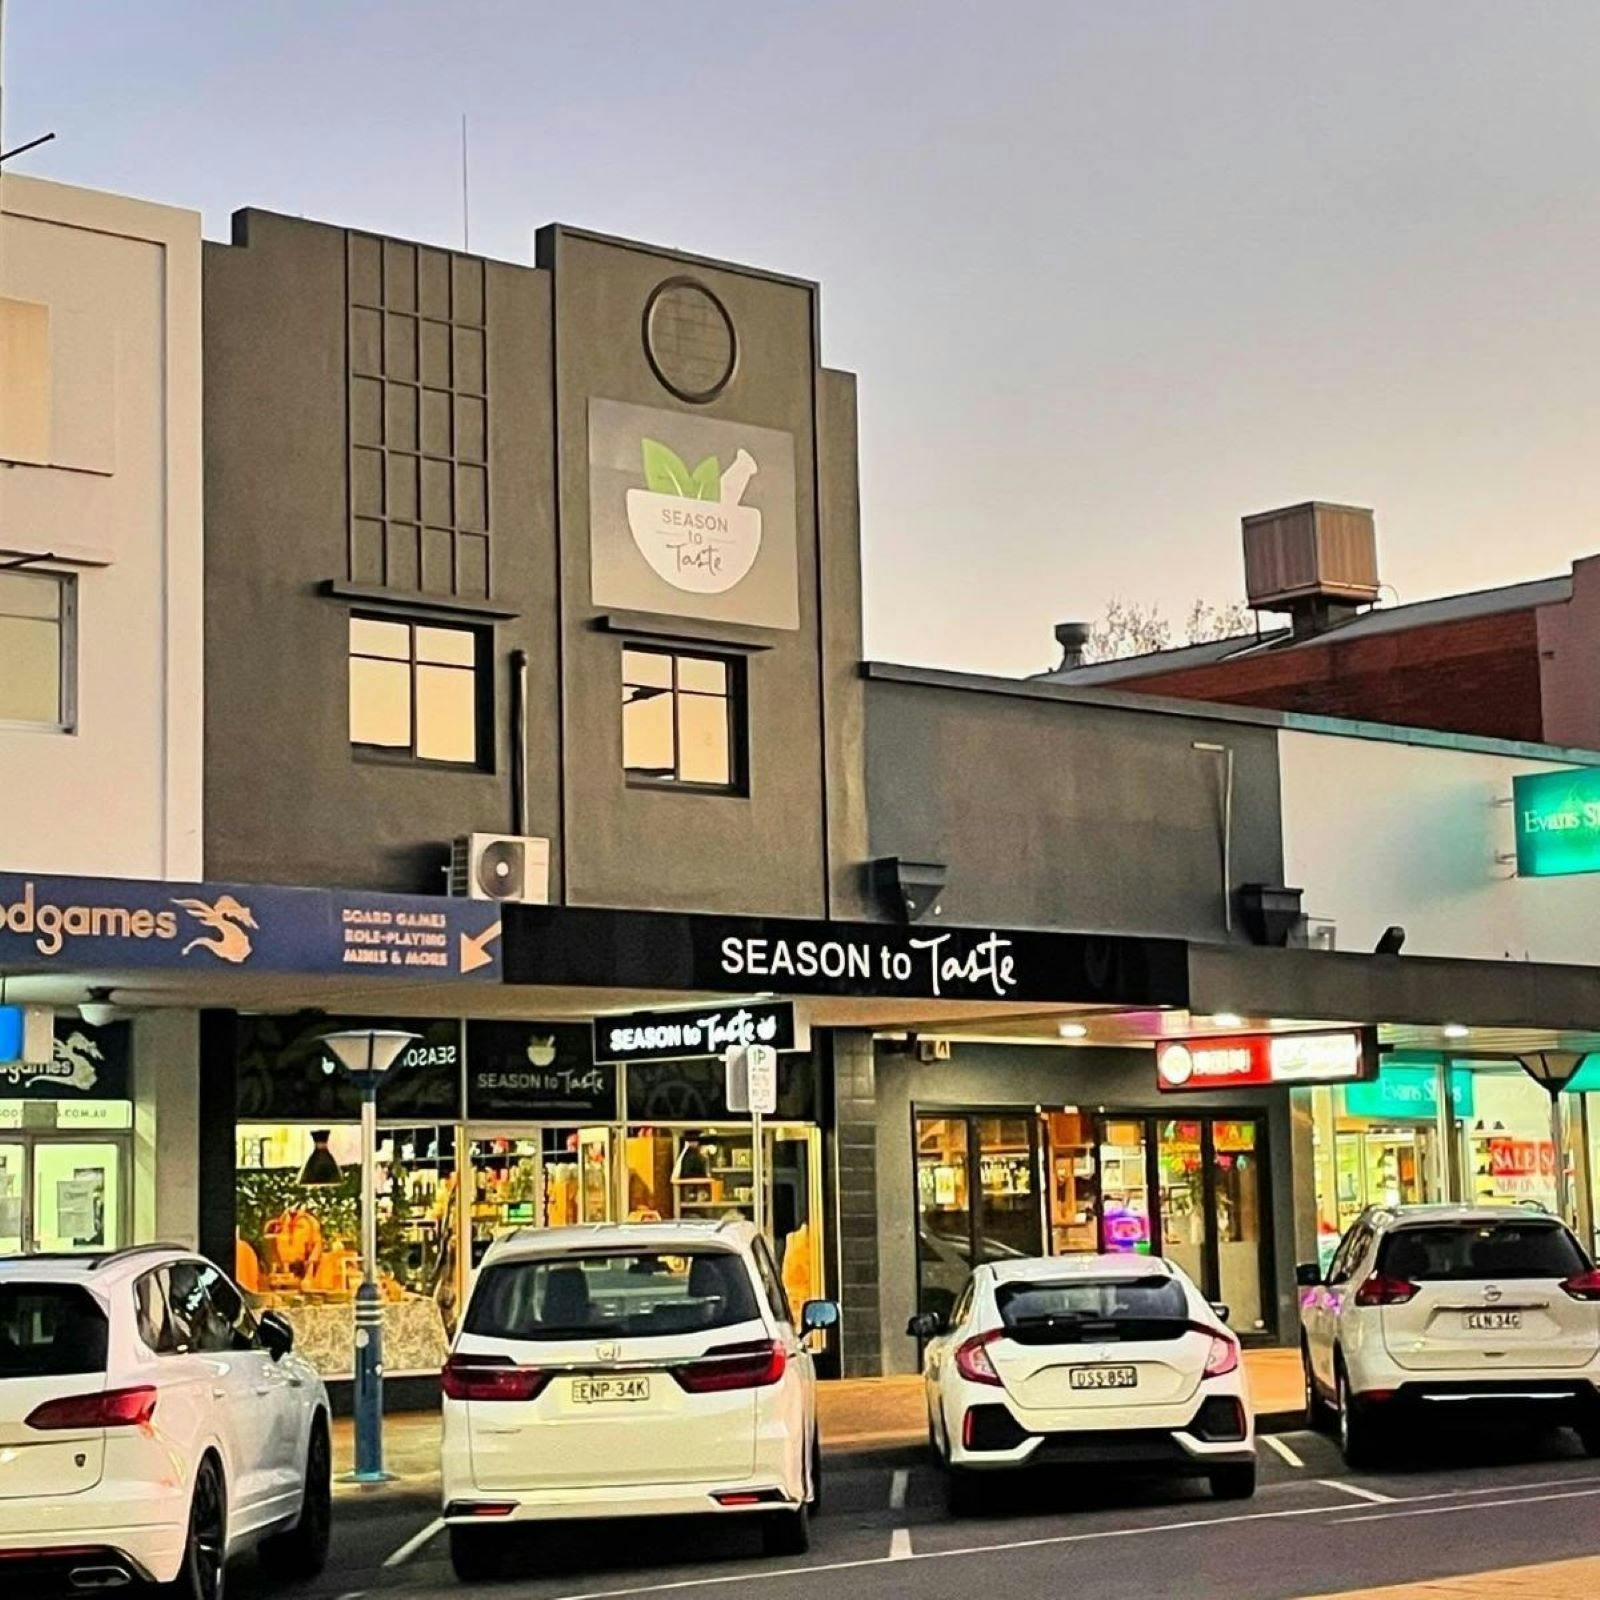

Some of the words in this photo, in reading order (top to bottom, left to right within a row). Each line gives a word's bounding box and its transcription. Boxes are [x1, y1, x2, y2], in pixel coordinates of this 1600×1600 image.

[661, 508, 729, 533] SEASON
[687, 530, 702, 544] to
[665, 543, 723, 577] Taste
[1523, 809, 1581, 833] Evans
[342, 908, 393, 925] BOARD
[395, 912, 447, 929] GAMES
[344, 928, 447, 946] ROLE-PLAYING
[343, 948, 388, 964] MINIS
[391, 950, 402, 965] &
[404, 951, 449, 967] MORE
[720, 936, 871, 979] SEASON
[880, 945, 912, 981] to
[908, 931, 1018, 997] Taste
[609, 1024, 682, 1052] SEASON
[682, 1023, 702, 1046] to
[696, 1008, 757, 1053] Taste
[477, 1073, 541, 1089] SEASON
[544, 1074, 558, 1089] to
[556, 1068, 605, 1094] Taste
[1493, 1148, 1535, 1170] SALE
